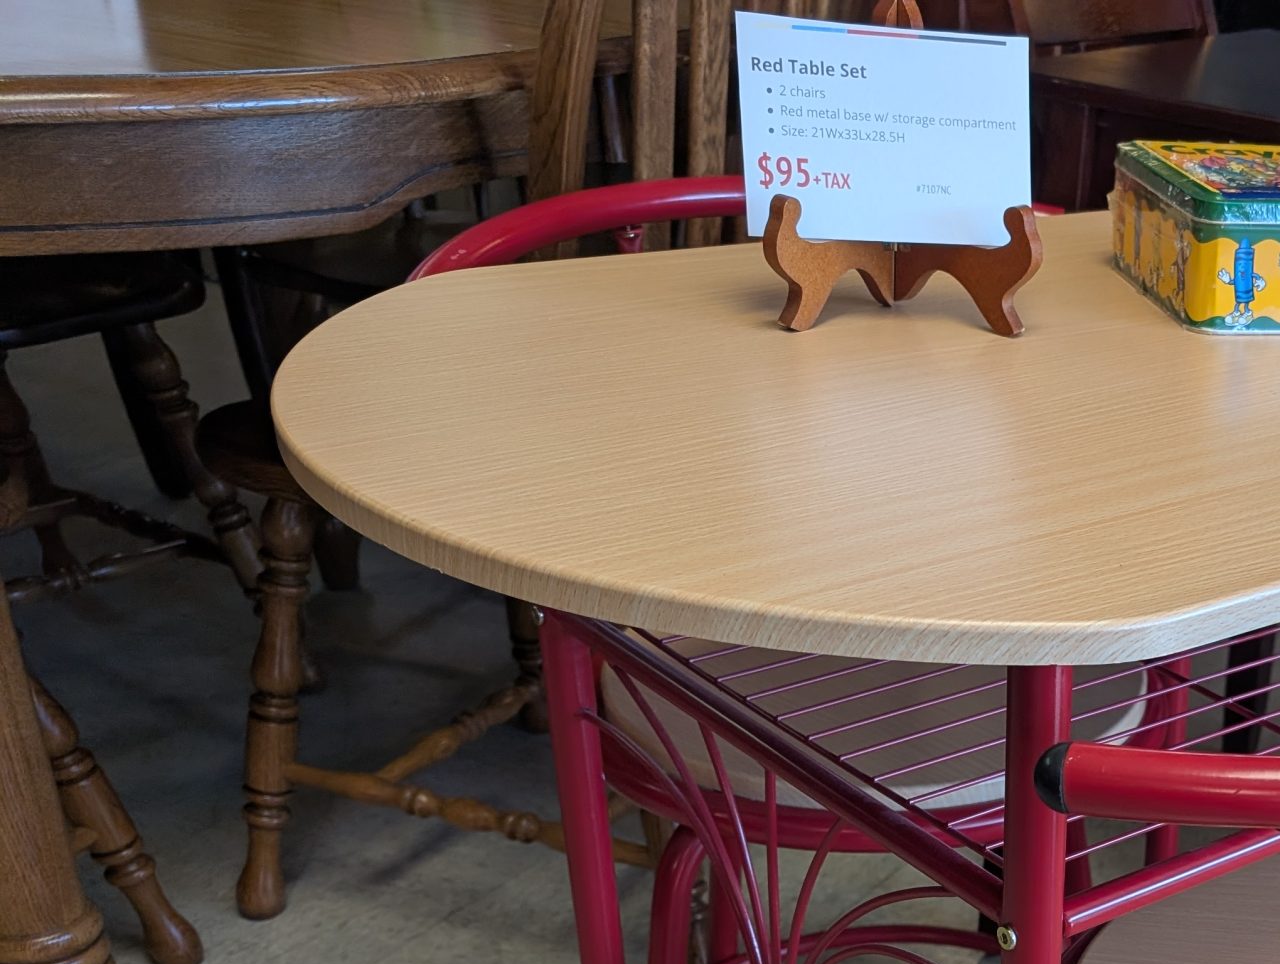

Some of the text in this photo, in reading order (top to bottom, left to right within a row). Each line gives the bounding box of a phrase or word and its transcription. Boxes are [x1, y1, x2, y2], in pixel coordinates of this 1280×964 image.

[751, 56, 868, 79] Red Table Set
[779, 85, 826, 99] 2 chairs
[780, 104, 1017, 131] Red metal base w/ storage compartment
[781, 125, 905, 143] Size: 21Wx33Lx28.5H
